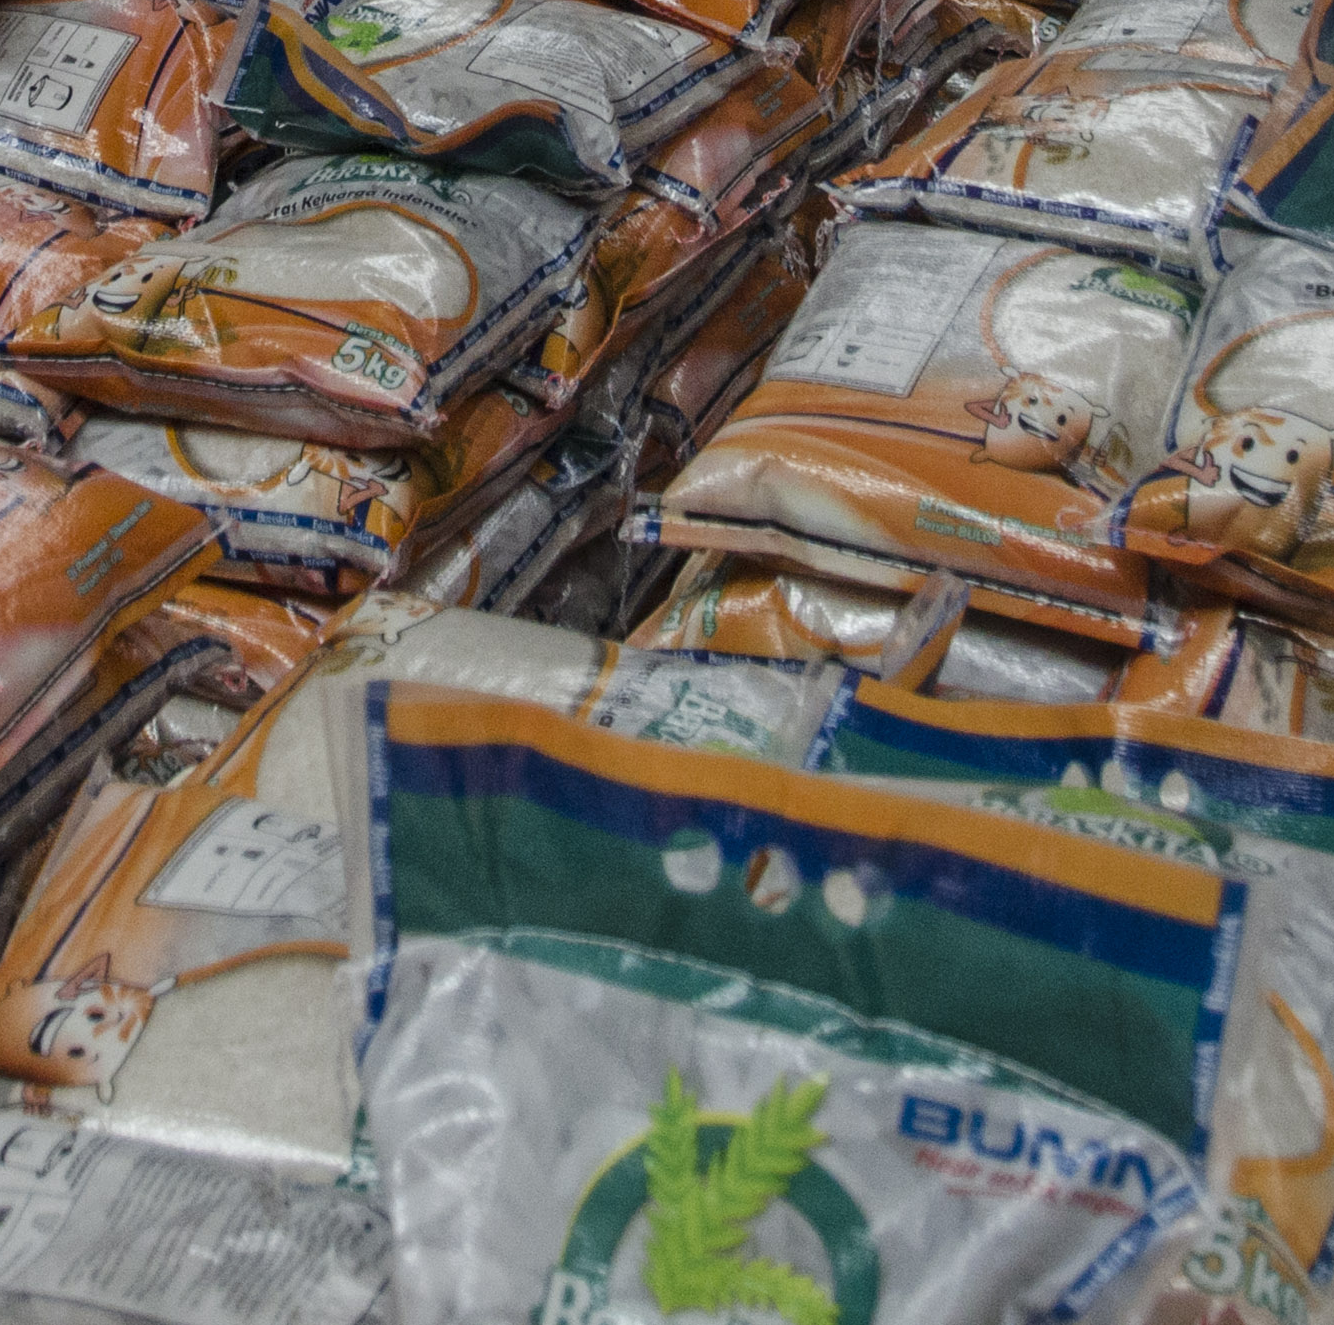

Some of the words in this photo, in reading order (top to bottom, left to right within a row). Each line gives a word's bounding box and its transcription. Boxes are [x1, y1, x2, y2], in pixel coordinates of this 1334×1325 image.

[300, 187, 377, 213] Keluarga
[333, 335, 407, 394] 5kg
[898, 1094, 1157, 1201] BUMN
